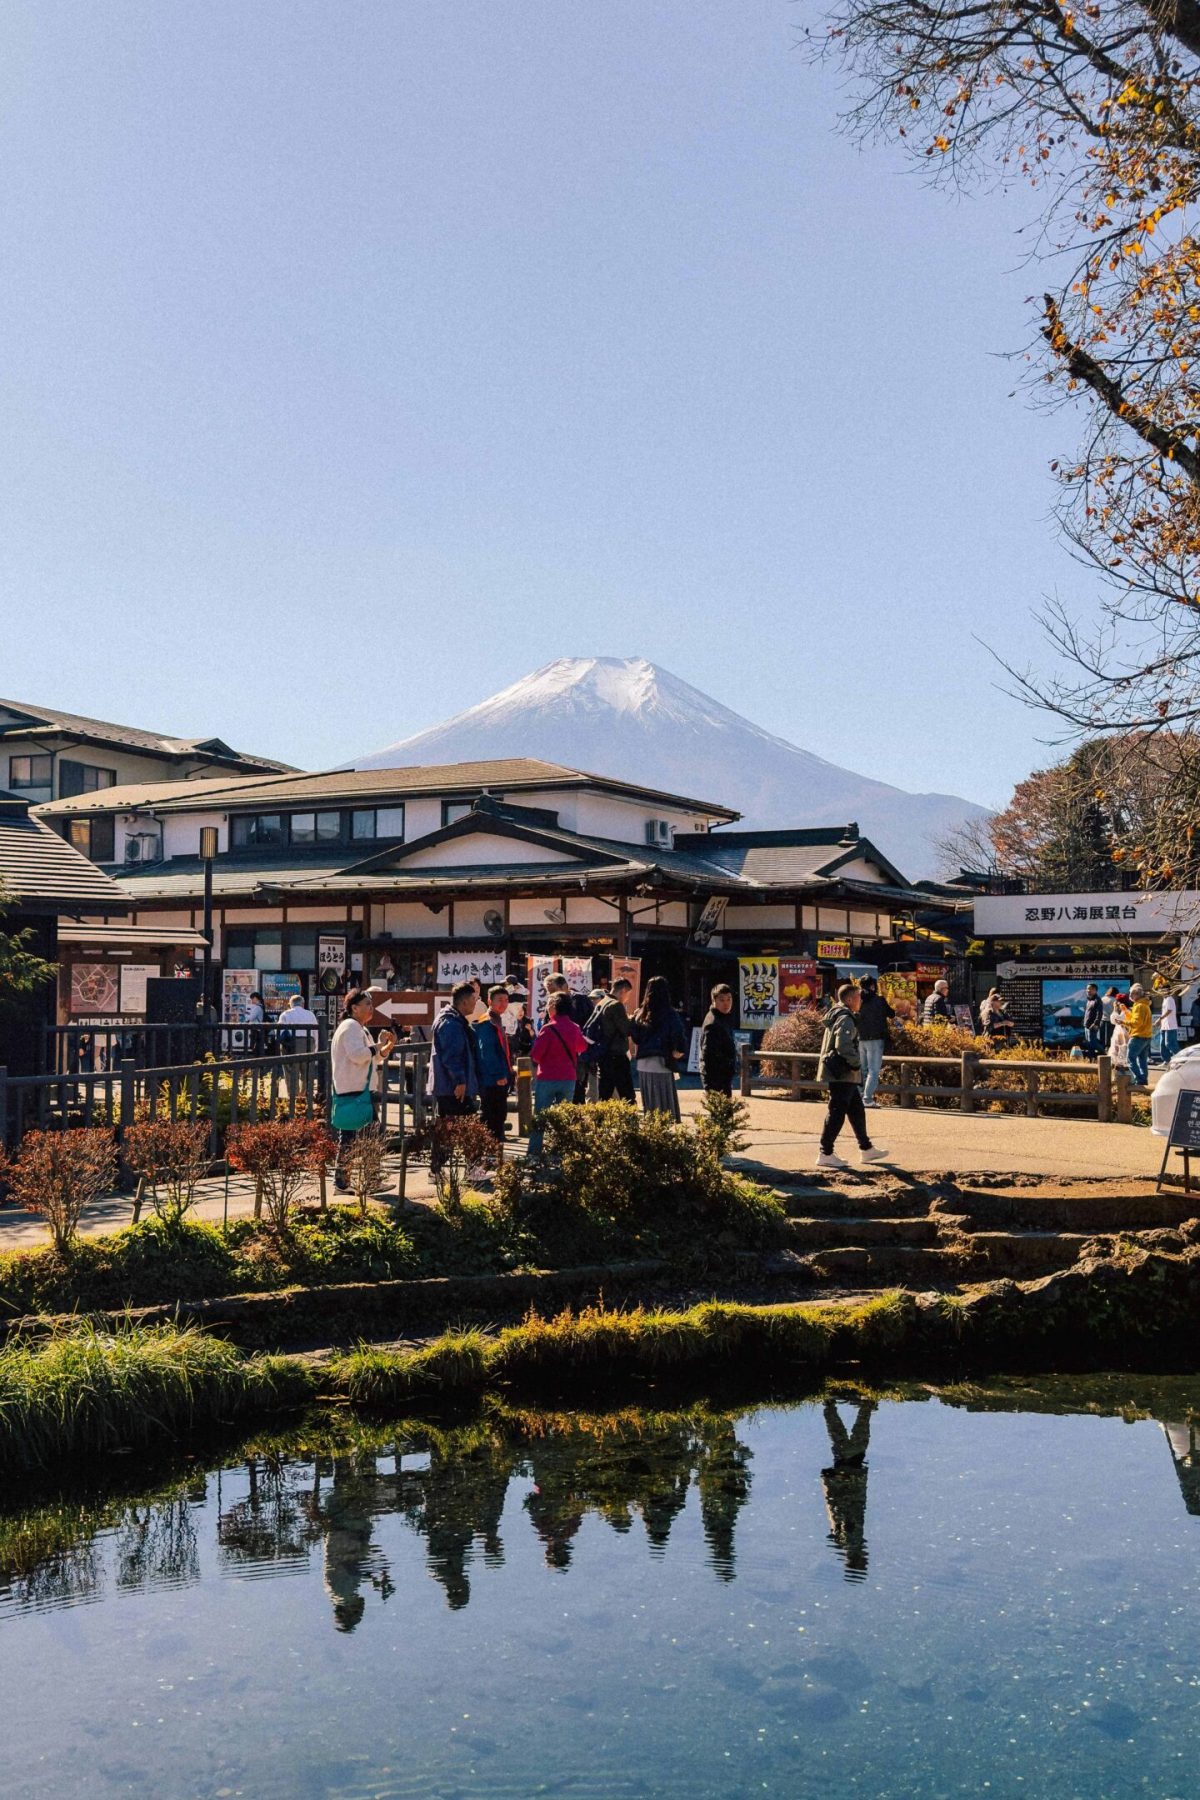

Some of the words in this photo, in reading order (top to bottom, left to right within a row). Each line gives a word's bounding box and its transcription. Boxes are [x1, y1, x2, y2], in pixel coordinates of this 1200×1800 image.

[1025, 905, 1137, 921] 忍野八海展望台
[320, 952, 344, 962] ほうとう
[441, 962, 503, 977] はんのき食堂
